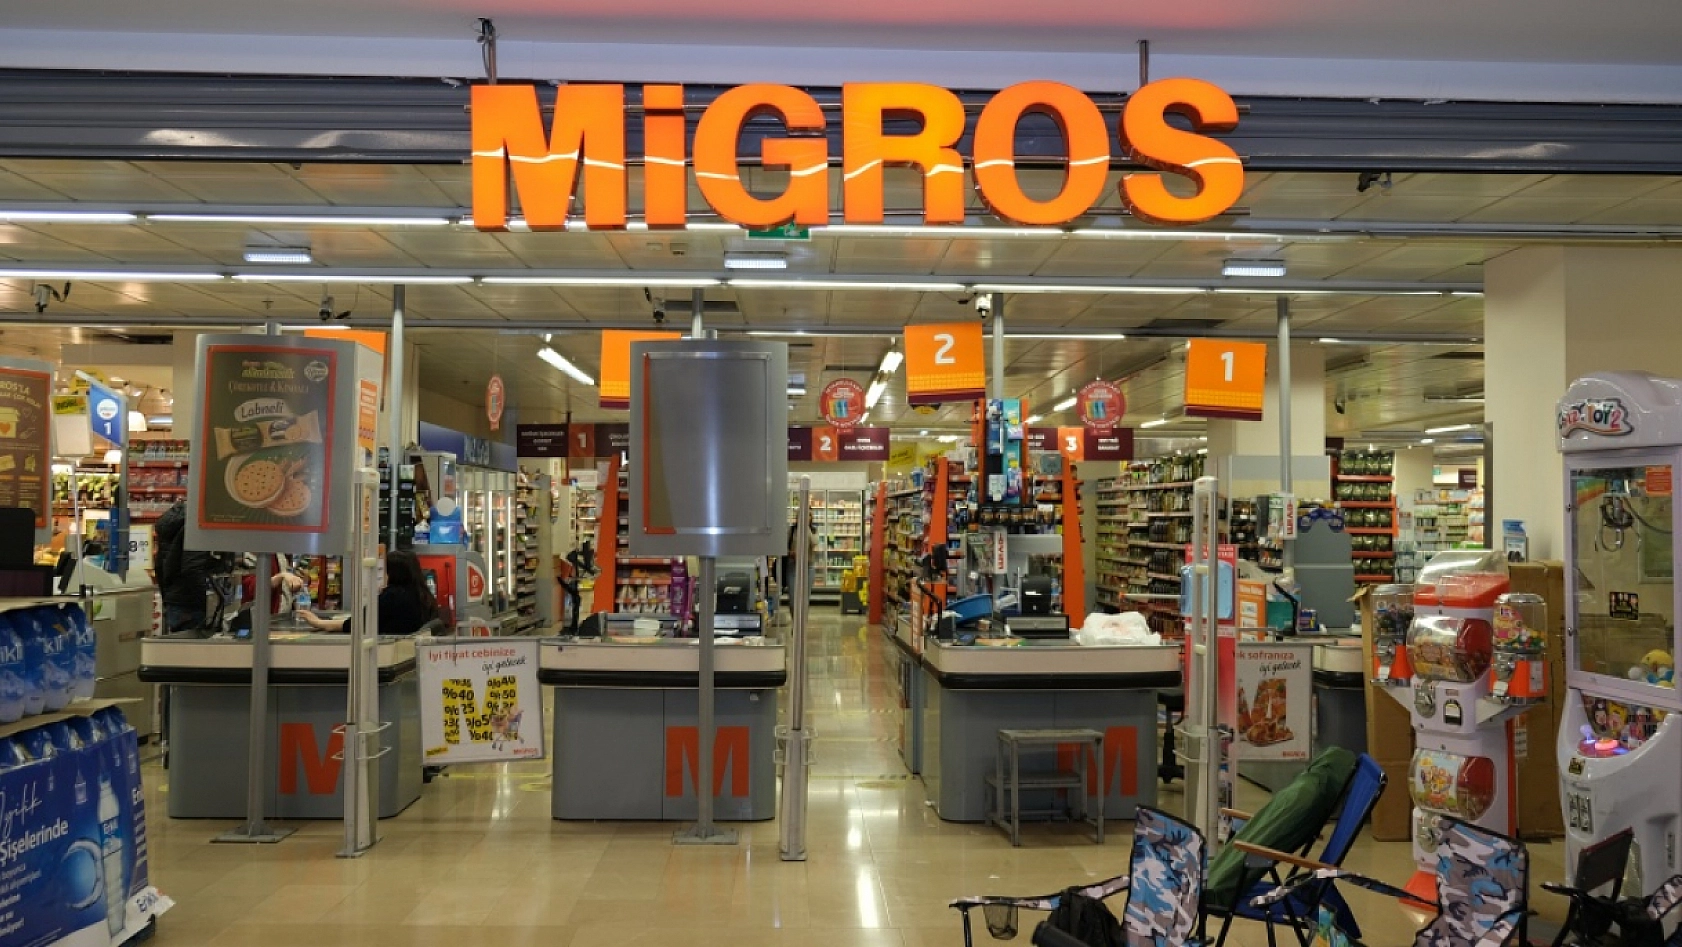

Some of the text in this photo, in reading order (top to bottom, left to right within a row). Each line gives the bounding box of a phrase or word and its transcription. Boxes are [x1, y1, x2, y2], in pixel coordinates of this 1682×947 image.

[934, 333, 956, 365] 2
[1221, 351, 1234, 382] 1
[241, 401, 284, 418] Labneli
[103, 421, 112, 436] 1
[577, 432, 587, 448] 1
[820, 435, 832, 452] 2
[1065, 436, 1078, 452] 3
[441, 686, 475, 701] %40
[665, 726, 750, 798] M
